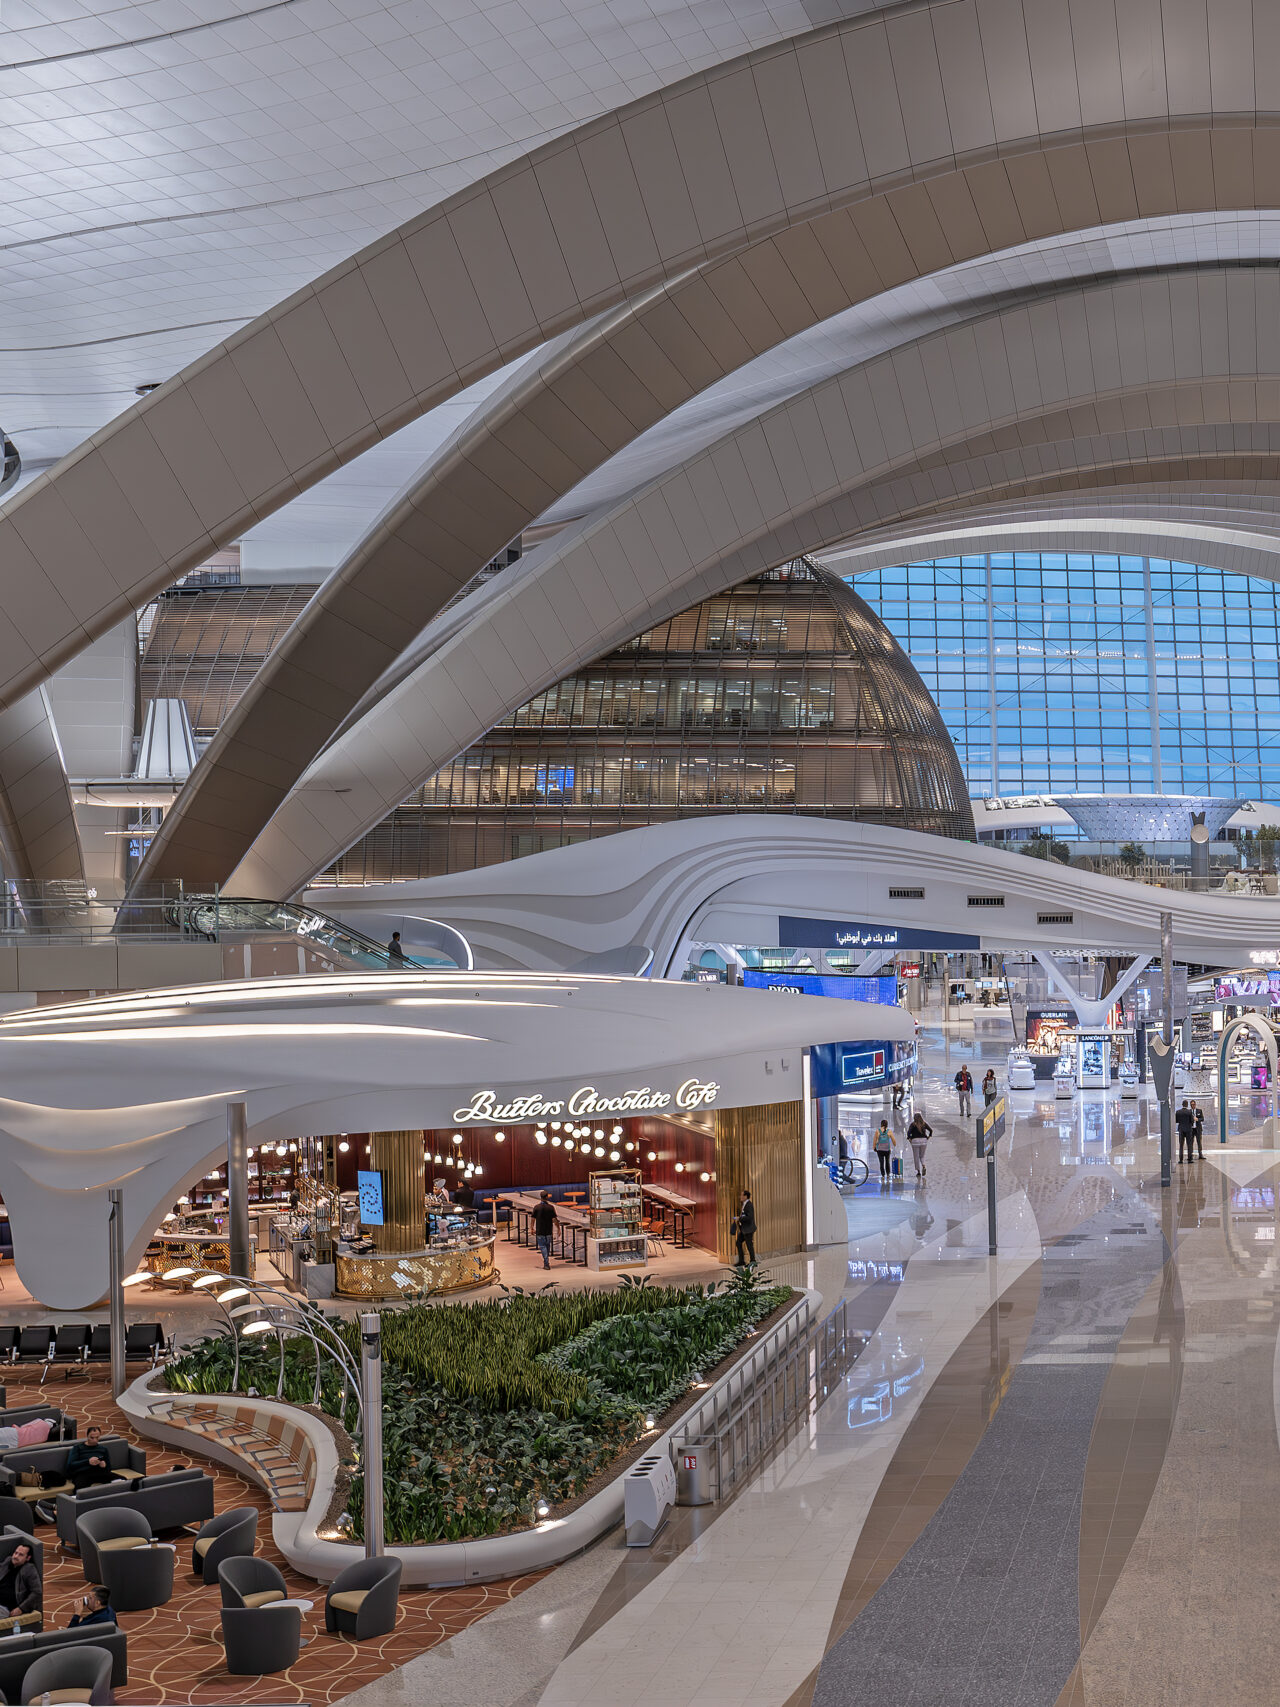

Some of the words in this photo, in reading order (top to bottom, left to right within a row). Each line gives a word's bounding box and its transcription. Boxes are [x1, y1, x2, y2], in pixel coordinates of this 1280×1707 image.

[861, 933, 872, 946] في
[872, 933, 883, 944] بك
[855, 1065, 874, 1077] Travelex
[453, 1090, 564, 1123] Butlers
[568, 1086, 671, 1116] Chocolate
[676, 1078, 721, 1110] Café
